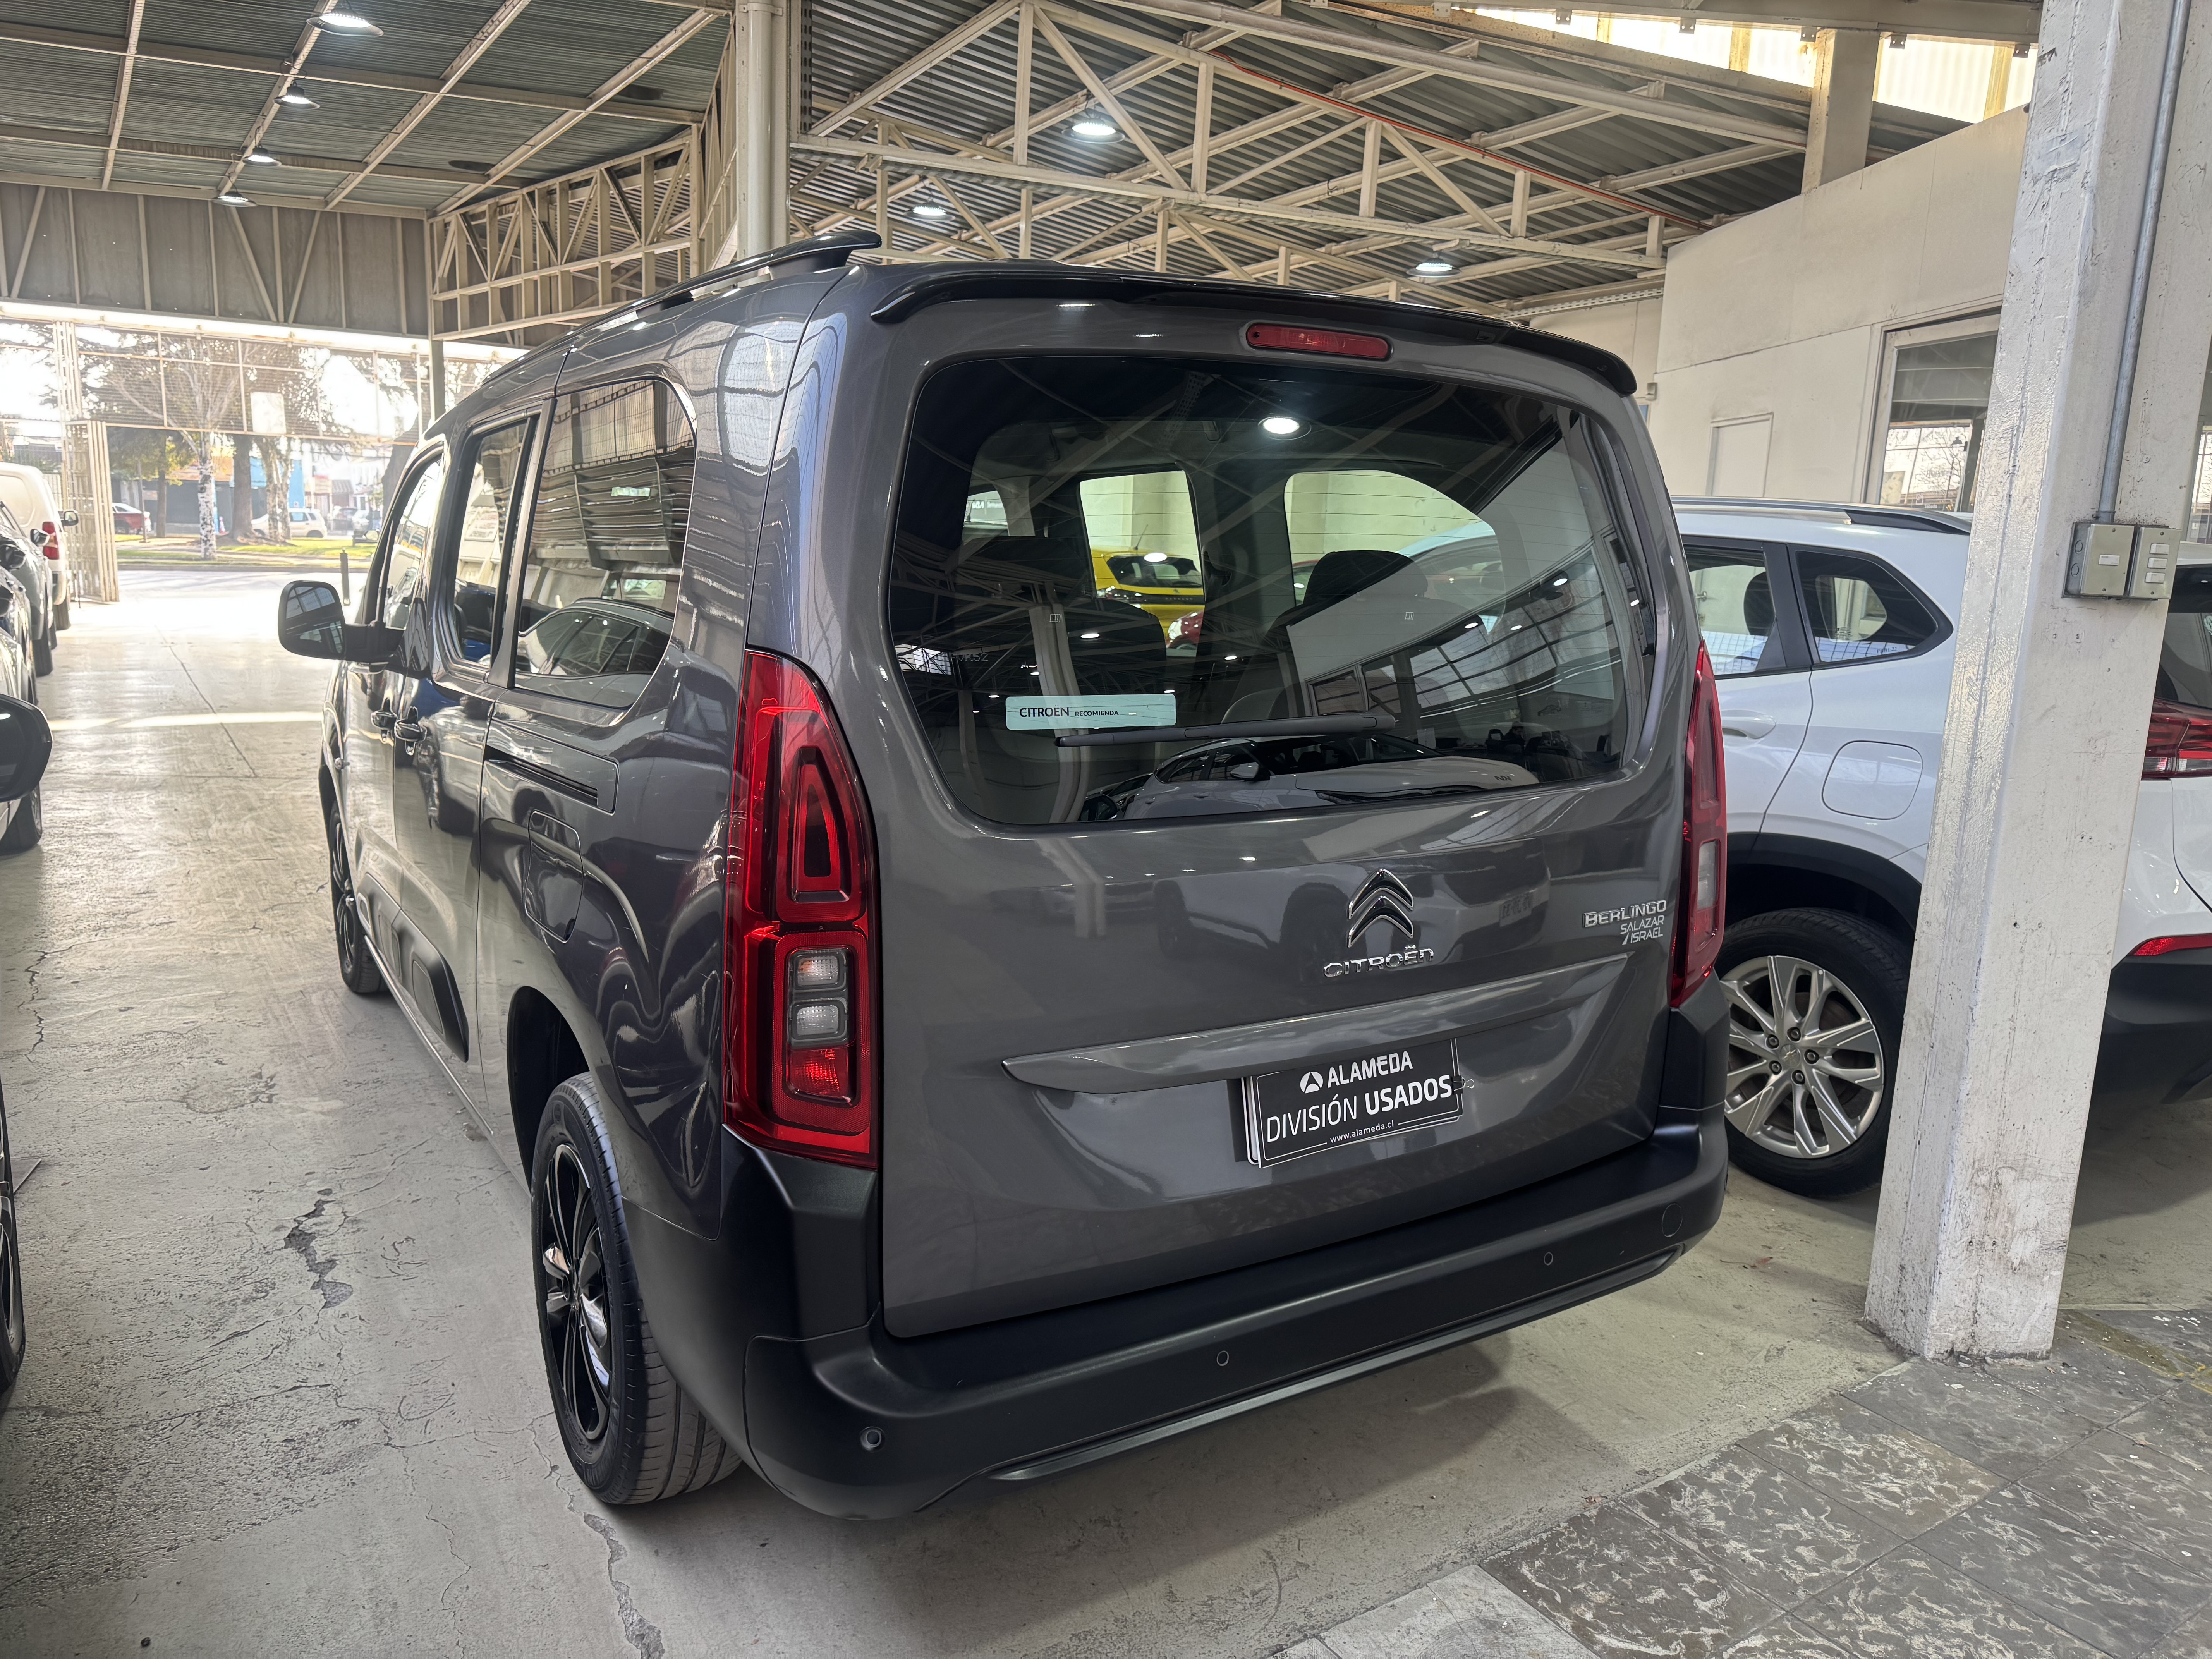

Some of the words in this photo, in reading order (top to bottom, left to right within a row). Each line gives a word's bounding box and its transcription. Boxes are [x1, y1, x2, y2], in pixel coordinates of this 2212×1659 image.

[1019, 705, 1069, 717] CITROËN
[1582, 900, 1667, 928] BERLINGO
[1620, 915, 1664, 934] SALAZAR
[1324, 945, 1434, 978] CITROËN
[1327, 1051, 1413, 1088] ALAMEDA
[1267, 1093, 1357, 1143] DIVISIÓN
[1365, 1075, 1452, 1115] USADOS
[1330, 1120, 1394, 1143] www.alameda.cl
